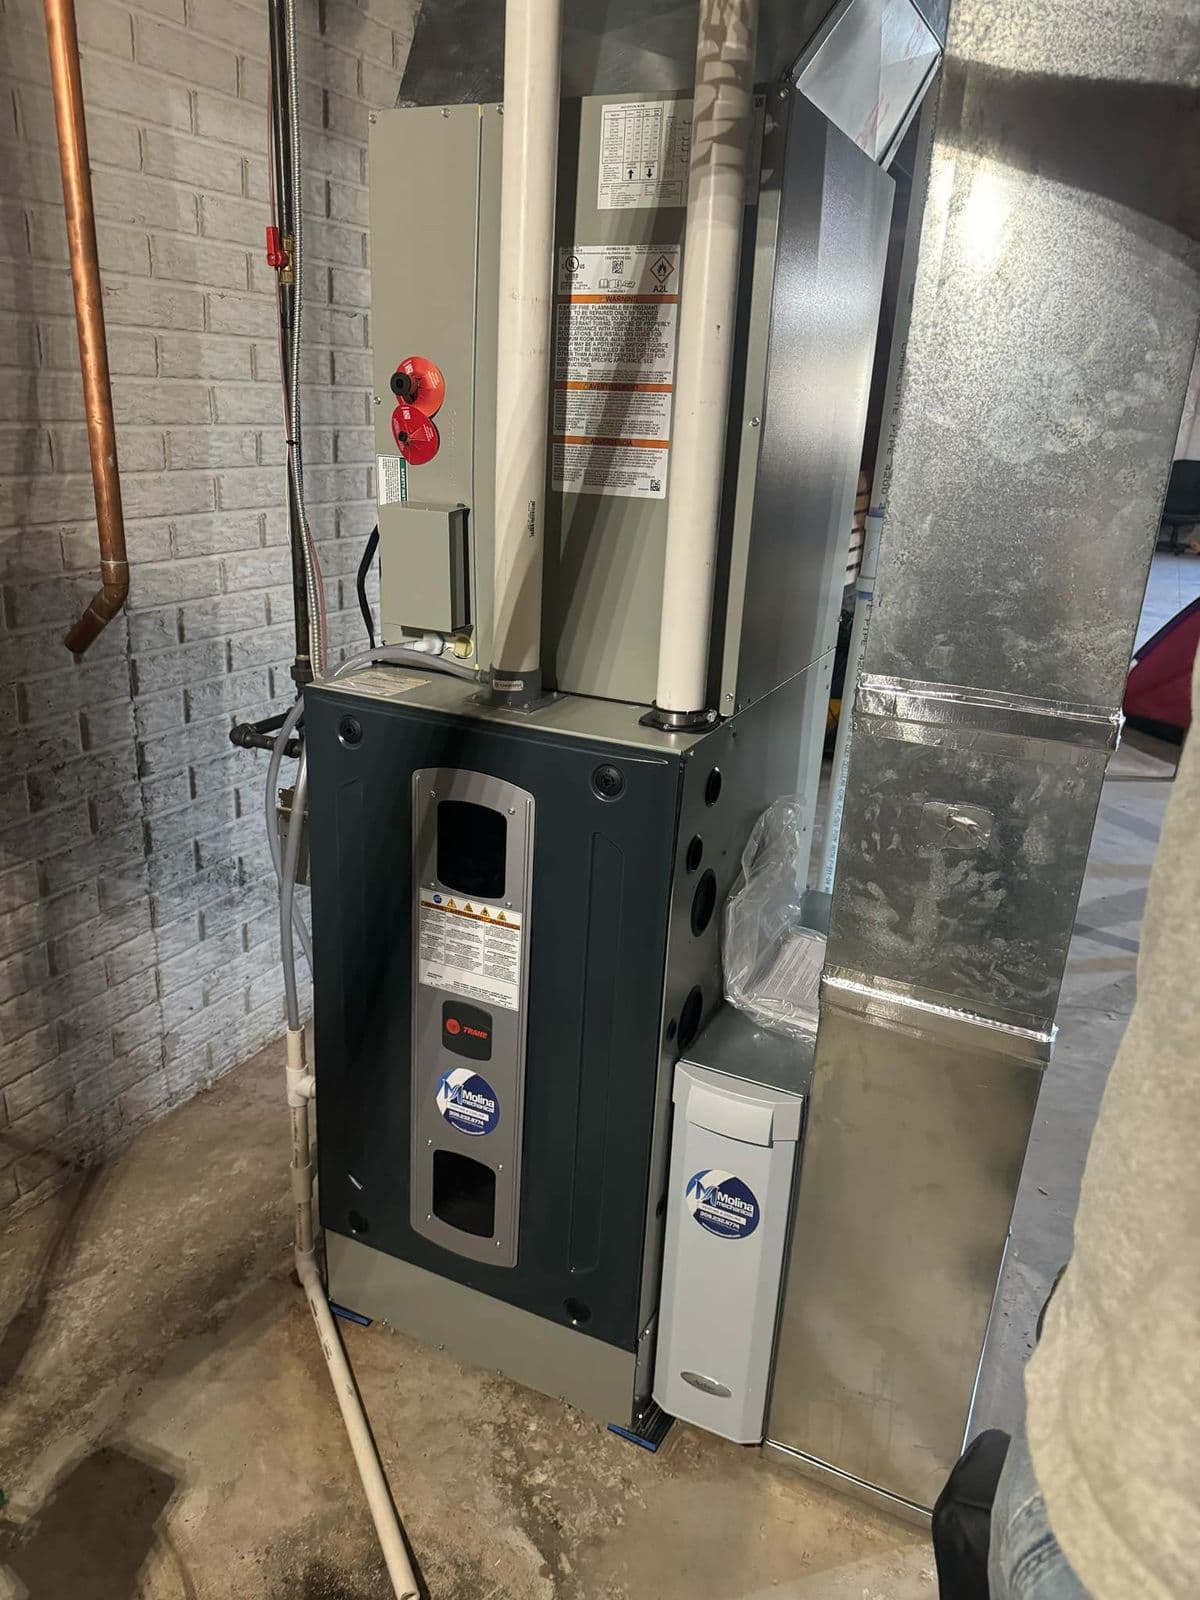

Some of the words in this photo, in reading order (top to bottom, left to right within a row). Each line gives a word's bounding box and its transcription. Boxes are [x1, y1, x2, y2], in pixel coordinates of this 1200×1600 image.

[886, 424, 898, 456] PIPE
[860, 618, 871, 646] PIPE
[464, 1026, 488, 1040] TRANE
[463, 1090, 494, 1106] Molina
[717, 1191, 754, 1211] Molina
